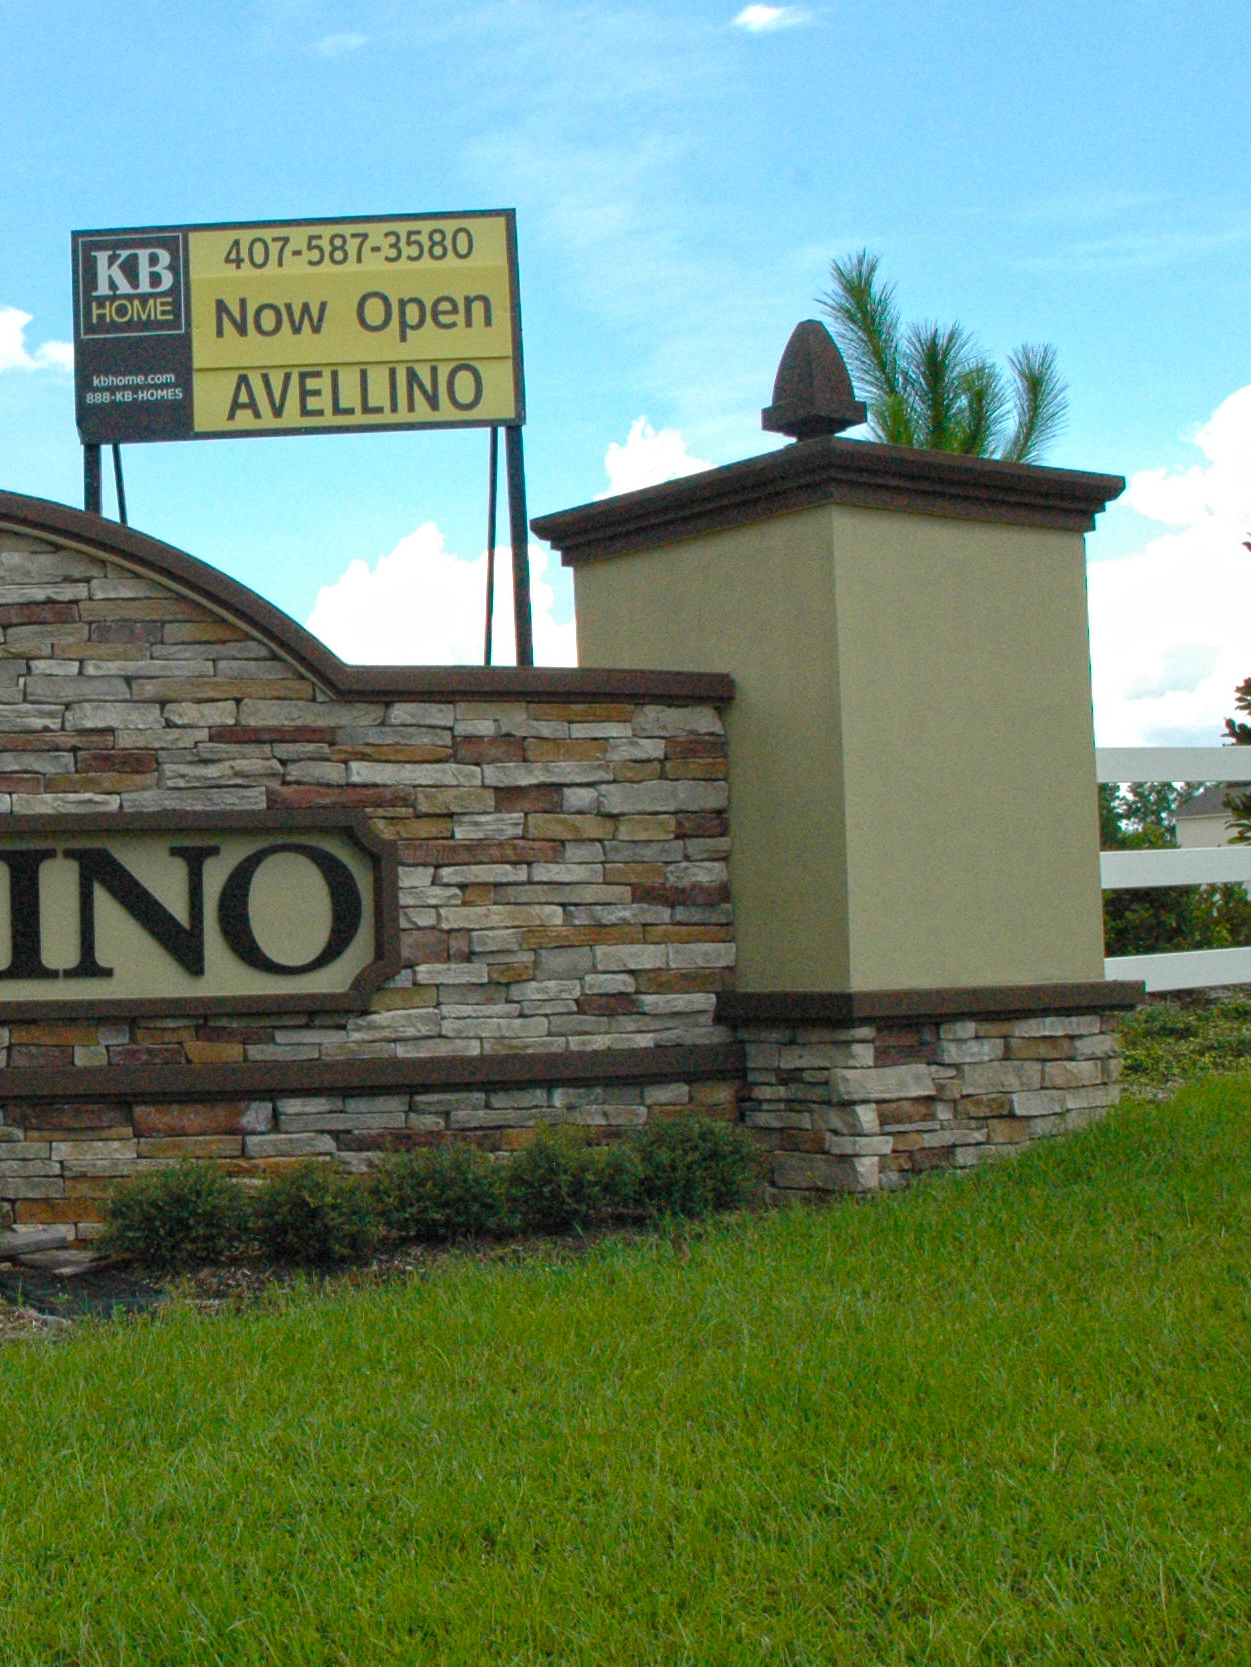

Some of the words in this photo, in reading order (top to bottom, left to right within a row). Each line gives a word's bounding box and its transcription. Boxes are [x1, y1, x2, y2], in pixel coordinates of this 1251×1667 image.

[224, 227, 474, 270] 407-587-3580
[90, 248, 174, 297] KB
[91, 297, 174, 324] HOME
[214, 297, 328, 339] Now
[356, 290, 493, 342] Open
[86, 388, 183, 403] 888-KB-HOMES
[93, 373, 175, 387] kbhome.com
[226, 362, 484, 421] AVELLINO
